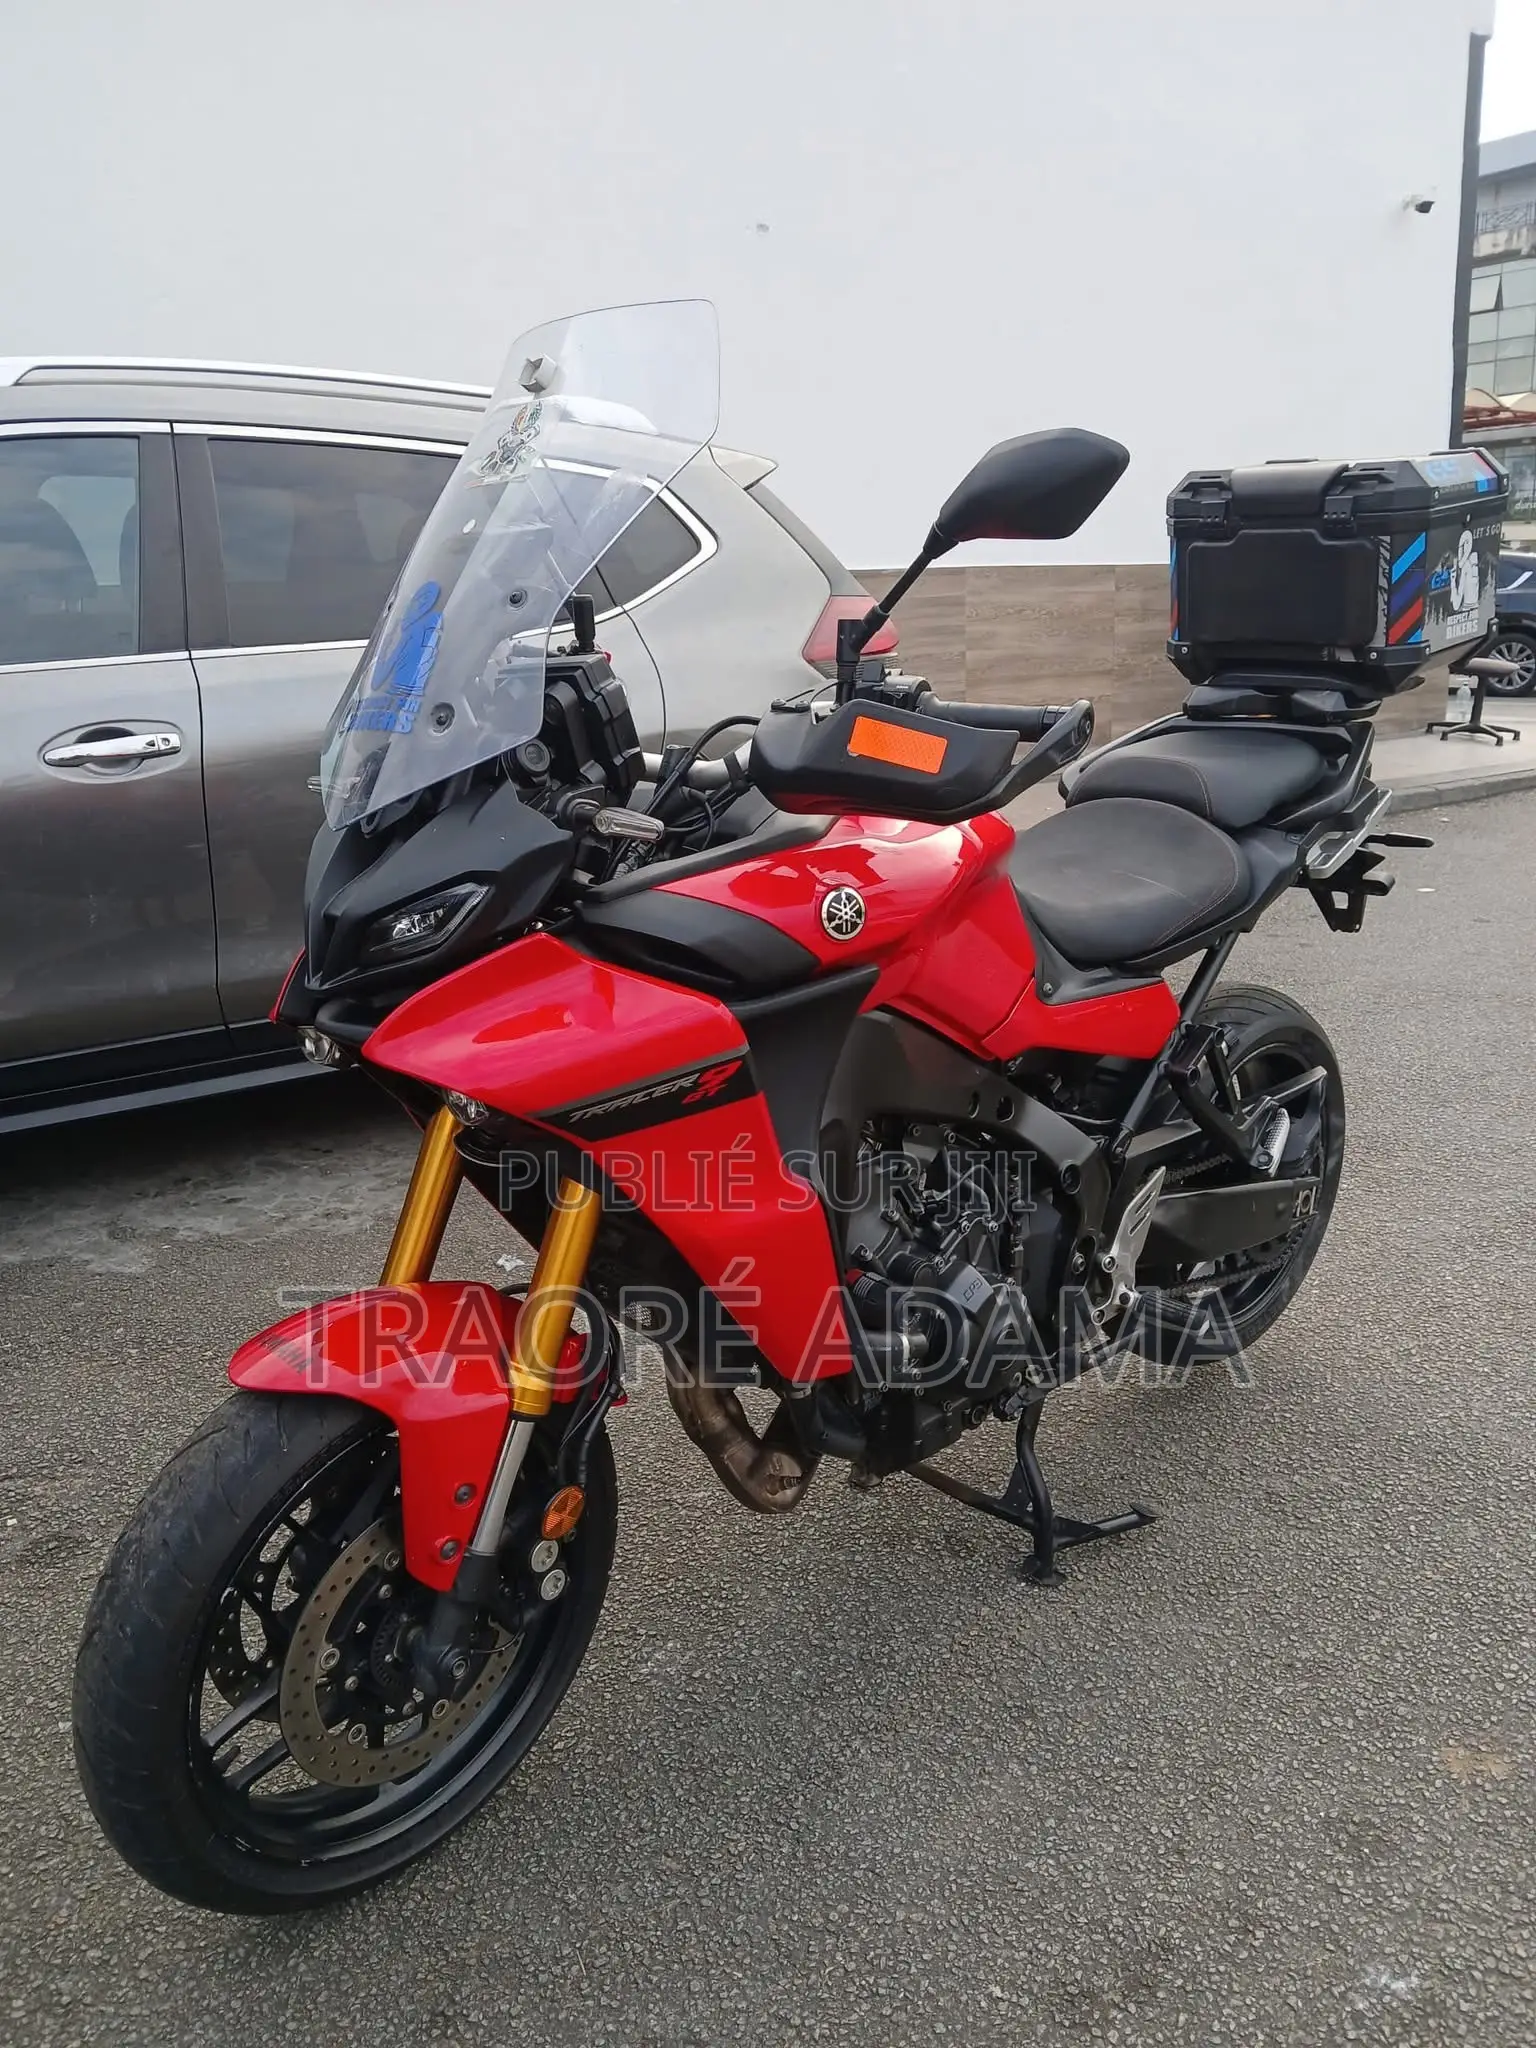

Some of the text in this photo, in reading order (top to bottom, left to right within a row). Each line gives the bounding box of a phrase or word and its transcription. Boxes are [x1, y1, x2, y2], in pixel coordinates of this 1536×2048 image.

[1446, 620, 1479, 640] BIKERS
[568, 1072, 700, 1124] TRACER
[680, 1083, 729, 1105] GT
